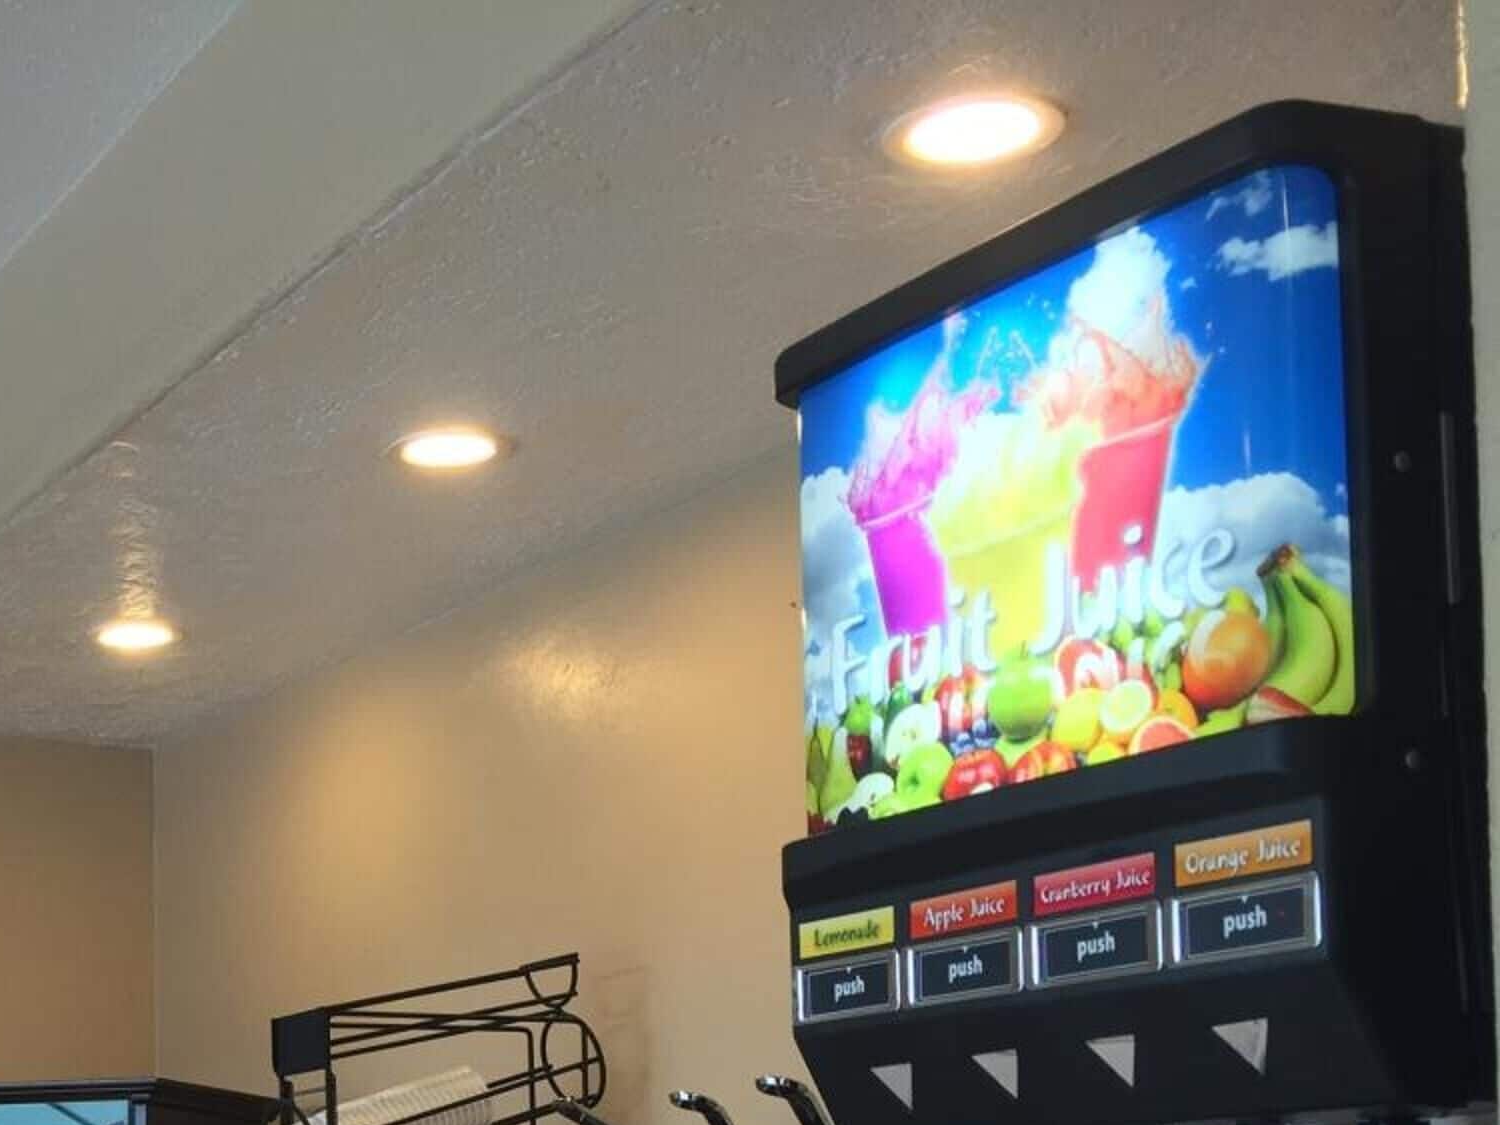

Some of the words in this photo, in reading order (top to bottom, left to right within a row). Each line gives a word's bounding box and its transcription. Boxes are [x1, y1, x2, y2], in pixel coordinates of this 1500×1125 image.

[831, 587, 998, 714] Fruit
[1028, 525, 1235, 654] Juice
[1184, 848, 1249, 876] Orange
[1258, 838, 1299, 863] Juice
[1040, 876, 1111, 904] Cranberry
[1115, 868, 1150, 889] Juice
[923, 904, 963, 931] Apple
[970, 896, 1005, 918] Juice
[1222, 903, 1268, 938] push
[814, 919, 879, 948] Lemonade
[1076, 930, 1116, 963] push
[948, 953, 983, 984] push
[834, 975, 865, 1004] push
